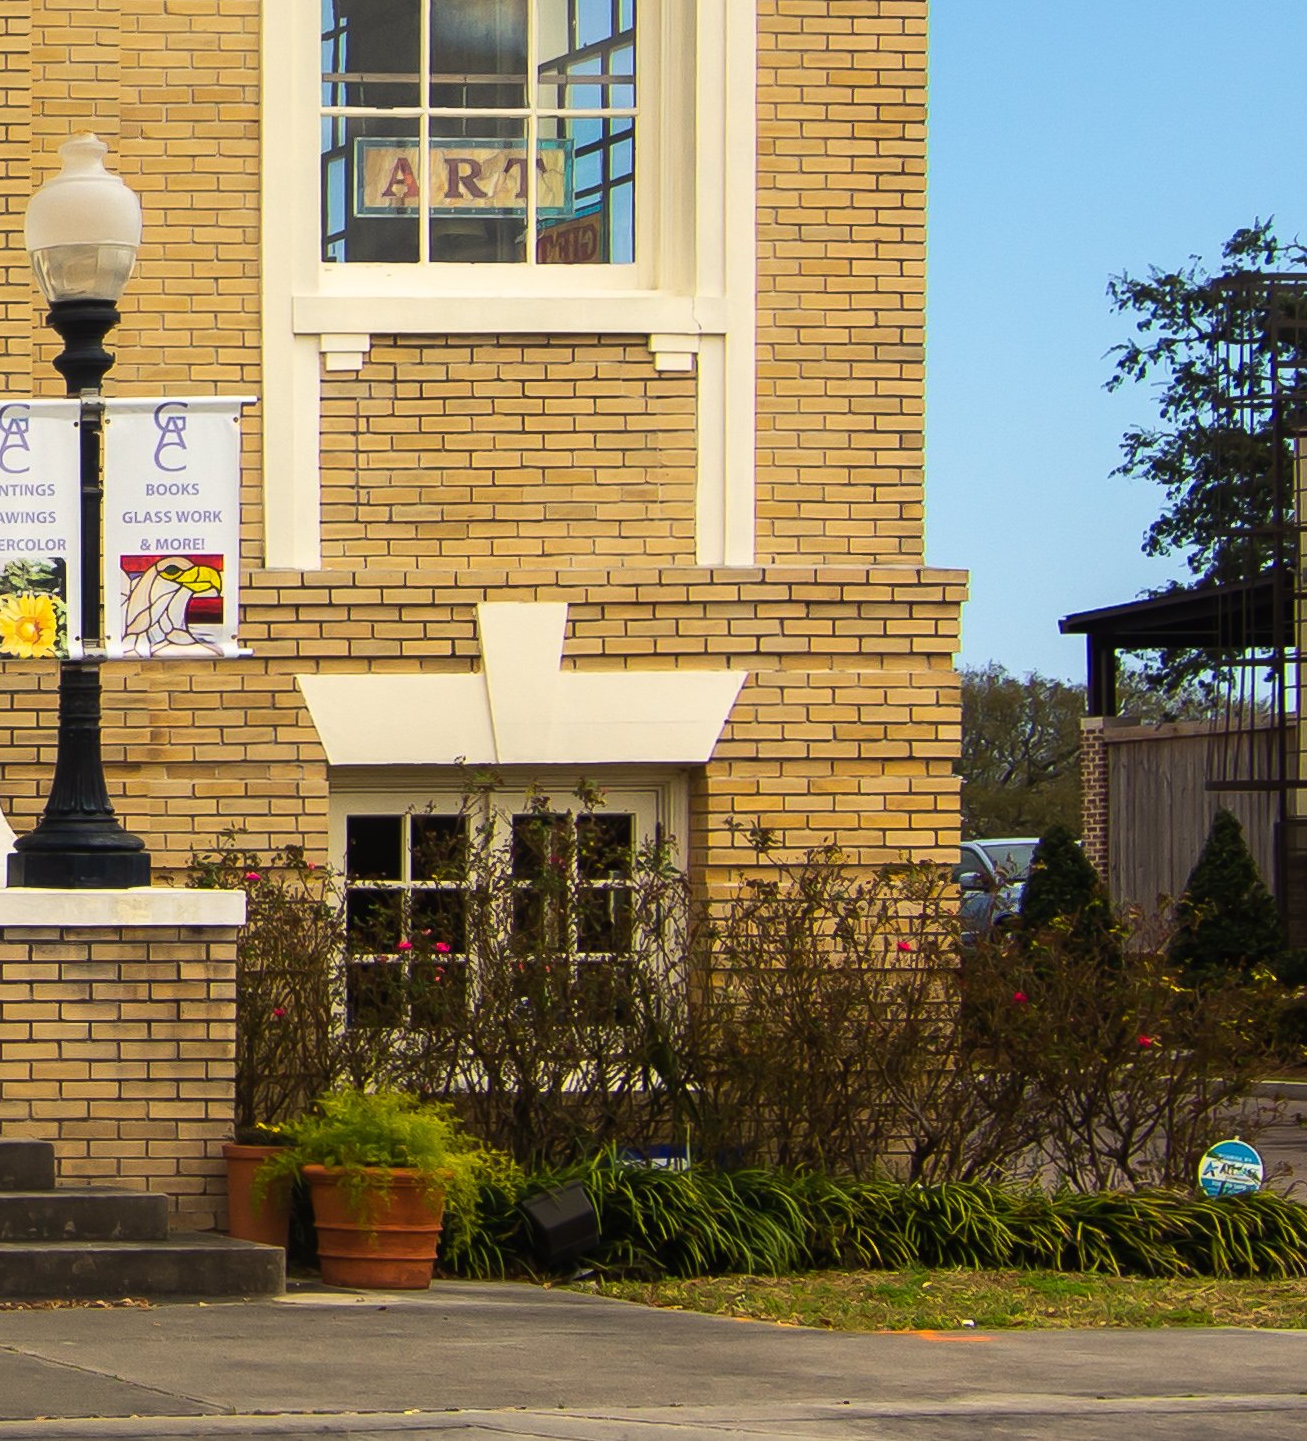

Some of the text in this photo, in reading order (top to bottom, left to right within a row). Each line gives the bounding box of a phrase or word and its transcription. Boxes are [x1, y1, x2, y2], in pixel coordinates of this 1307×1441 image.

[381, 157, 547, 199] ART
[145, 483, 200, 496] BOOKS
[122, 509, 223, 524] GLASS WORK
[139, 538, 206, 551] & MORE!
